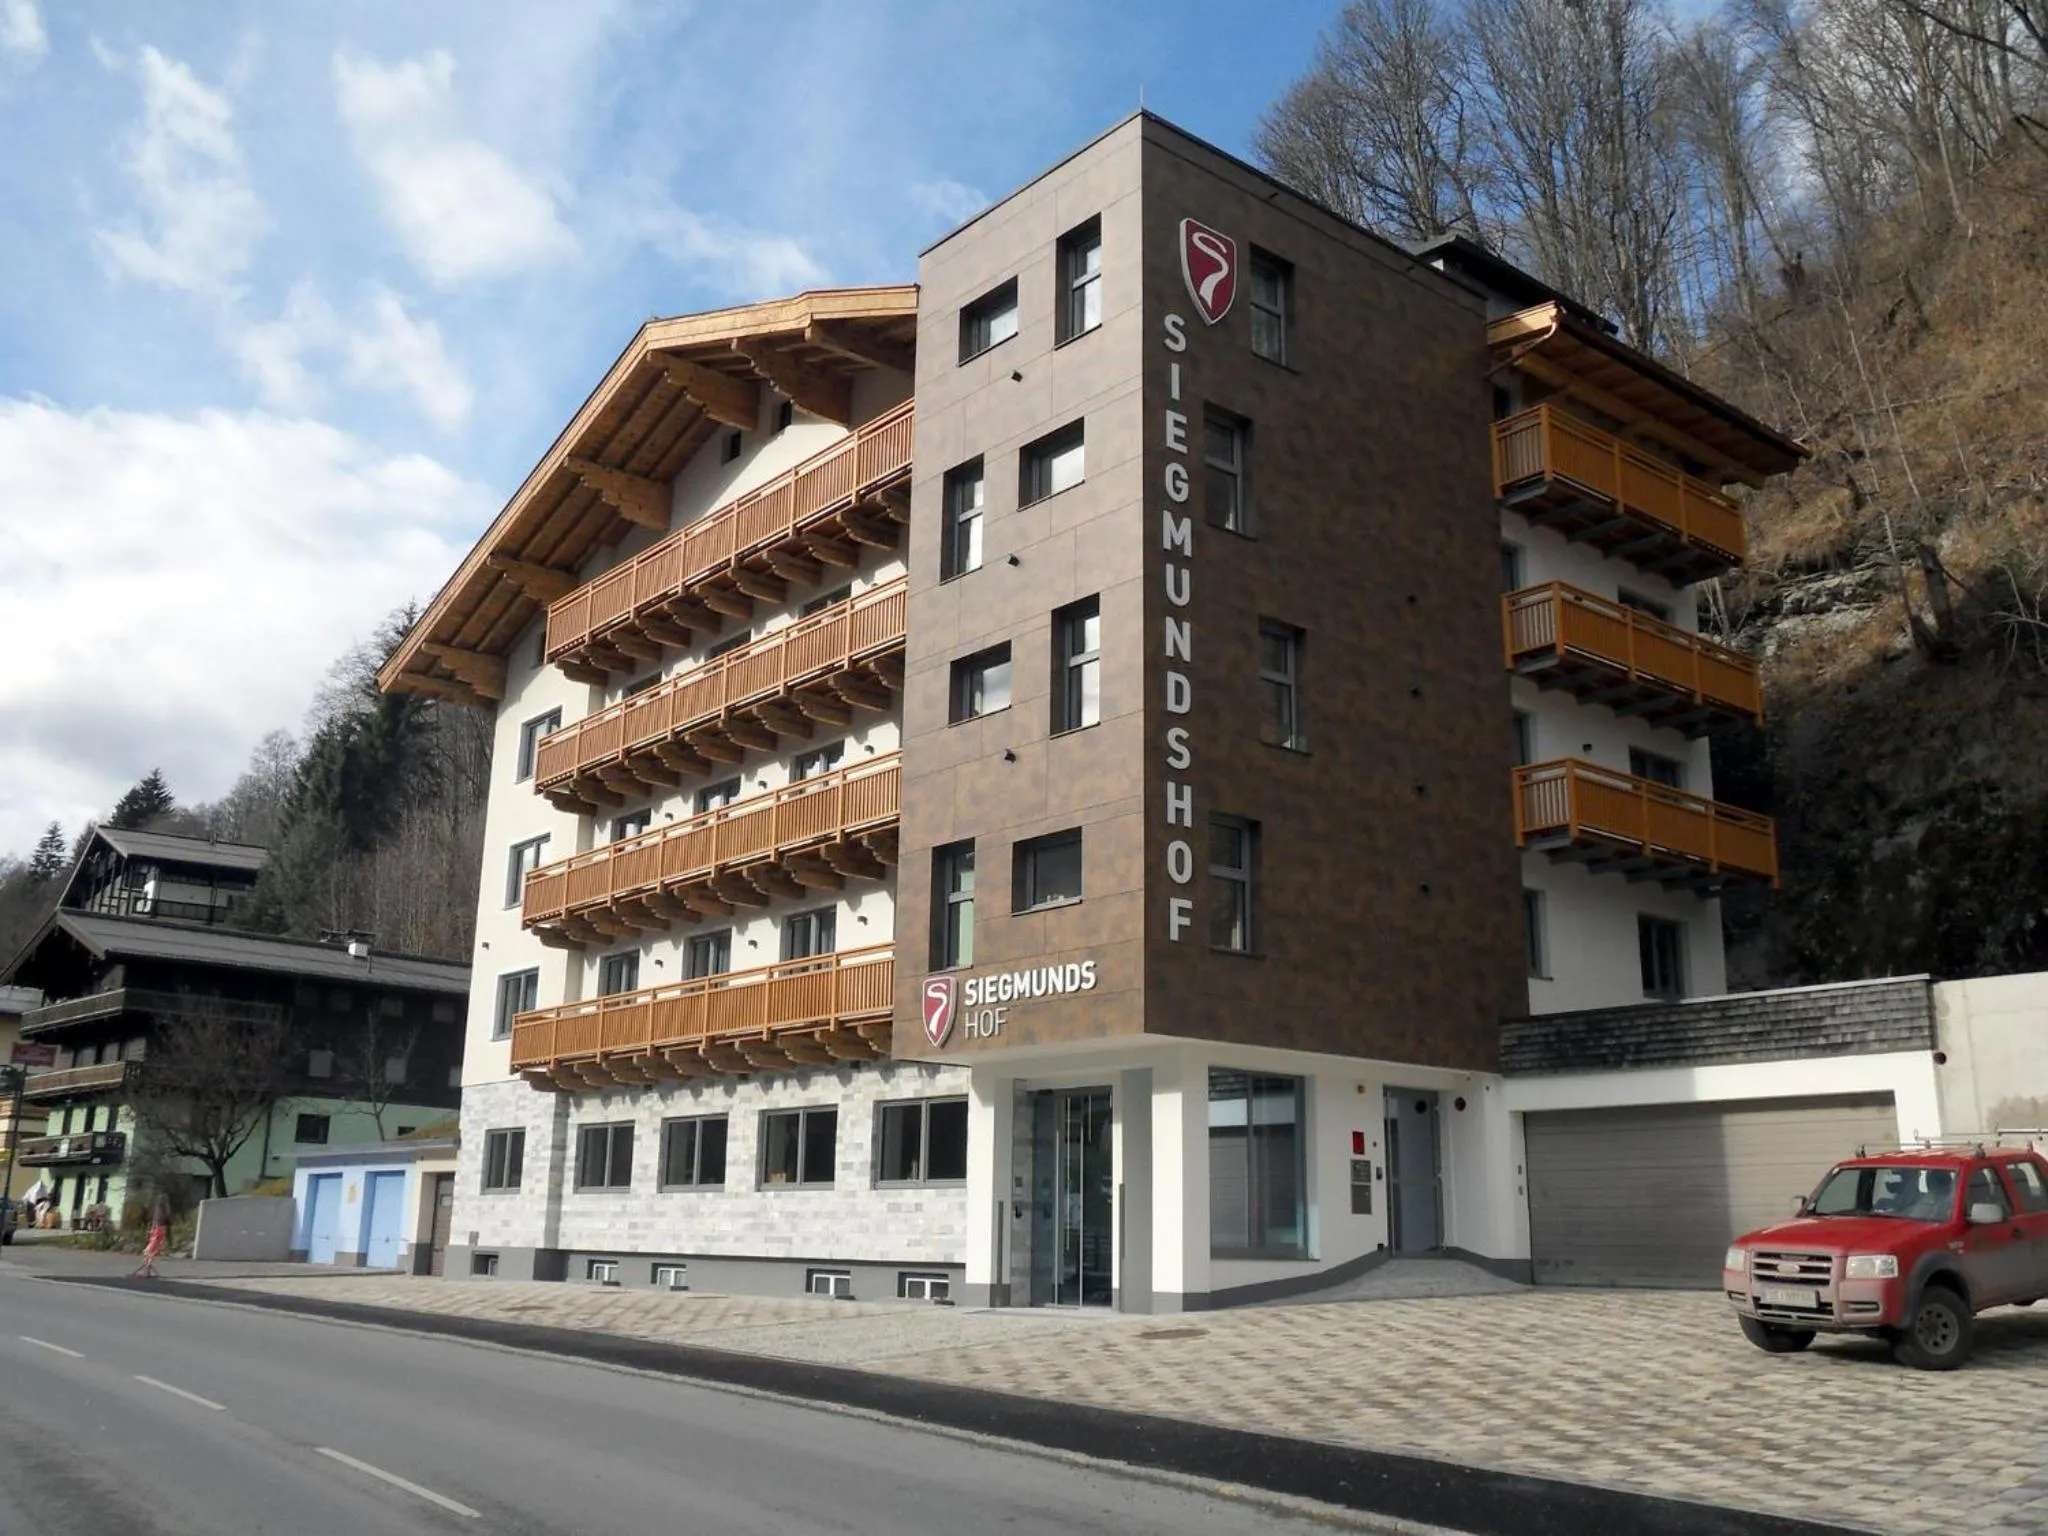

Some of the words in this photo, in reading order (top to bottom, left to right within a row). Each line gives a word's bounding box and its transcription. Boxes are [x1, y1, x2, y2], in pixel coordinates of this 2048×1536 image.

[1162, 313, 1194, 941] SIEGMUNDSHOF
[964, 960, 1097, 1006] SIEGMUNDS
[964, 1007, 1009, 1039] HOF
